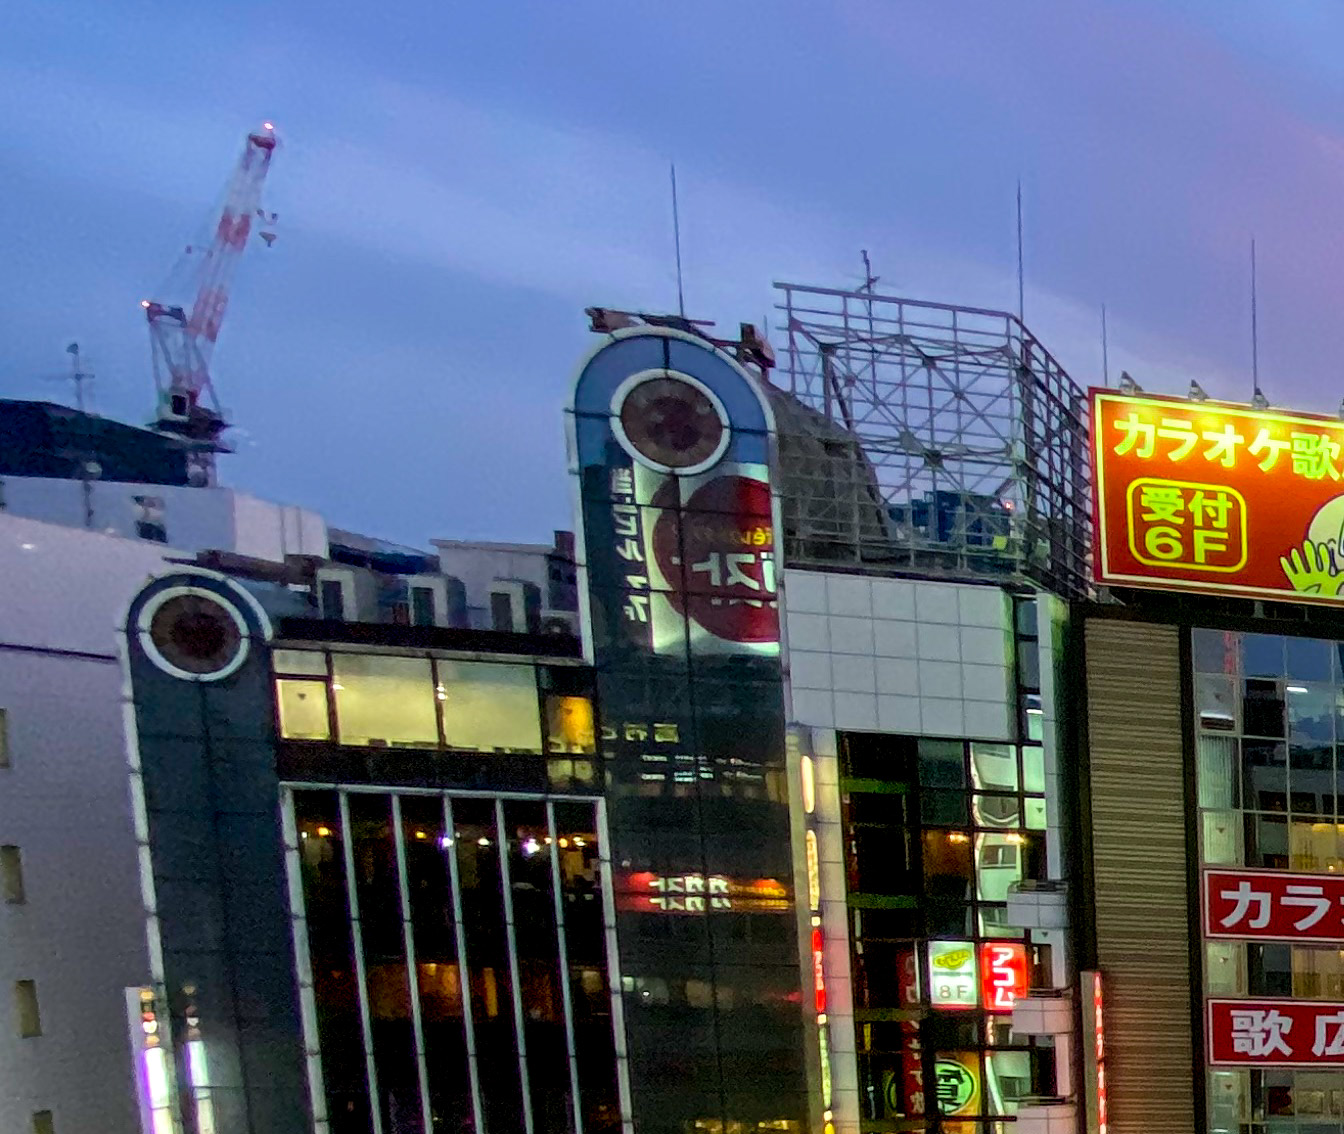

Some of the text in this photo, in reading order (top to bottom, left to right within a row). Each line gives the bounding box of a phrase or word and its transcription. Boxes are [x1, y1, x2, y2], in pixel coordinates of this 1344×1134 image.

[1140, 486, 1233, 529] 受付
[1144, 528, 1229, 564] 6F
[940, 985, 967, 999] 8F
[992, 947, 1015, 1006] アコム
